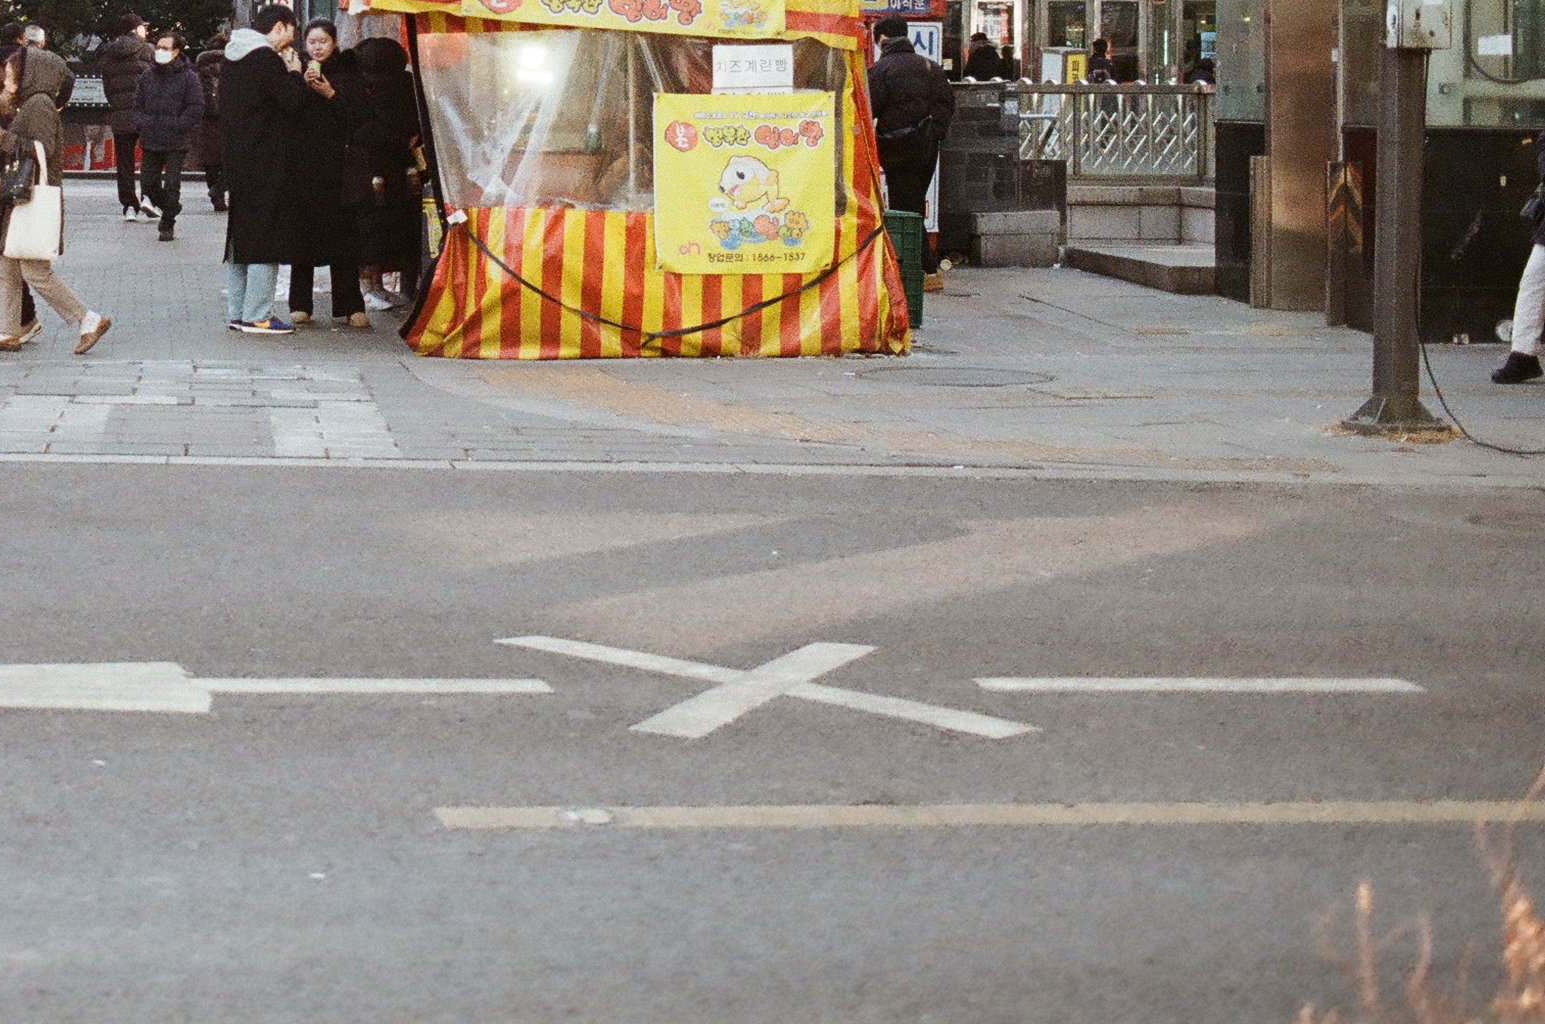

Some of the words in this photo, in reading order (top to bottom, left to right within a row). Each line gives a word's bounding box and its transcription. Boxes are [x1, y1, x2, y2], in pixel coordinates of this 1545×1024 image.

[715, 57, 787, 73] 치즈계란빵
[702, 124, 751, 149] 행복한
[754, 119, 825, 150] 잉어빵
[751, 251, 806, 263] 1566-1537
